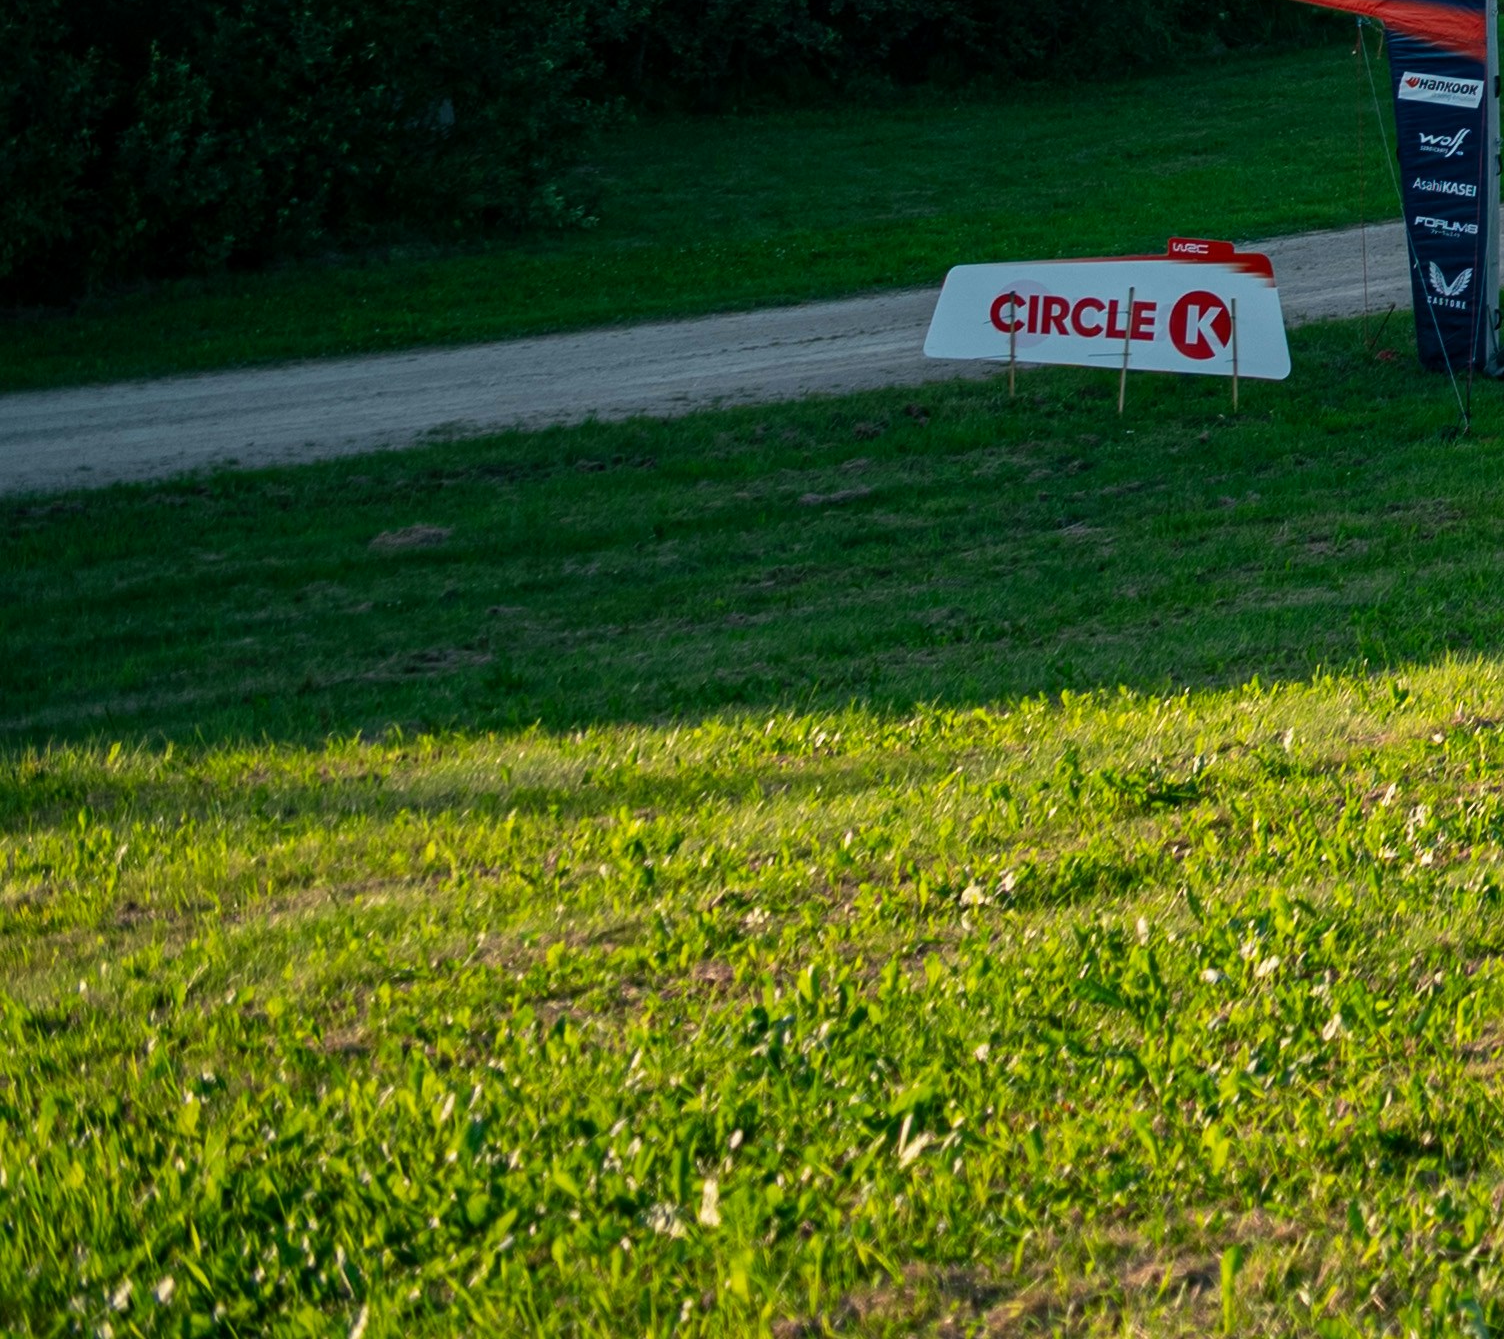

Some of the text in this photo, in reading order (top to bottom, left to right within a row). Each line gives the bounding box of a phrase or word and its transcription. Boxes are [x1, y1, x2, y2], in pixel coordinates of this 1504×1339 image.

[1414, 215, 1479, 235] FORUM8
[1172, 242, 1209, 254] WRC
[1427, 295, 1466, 310] CASTORE
[989, 292, 1157, 341] CIRCLE
